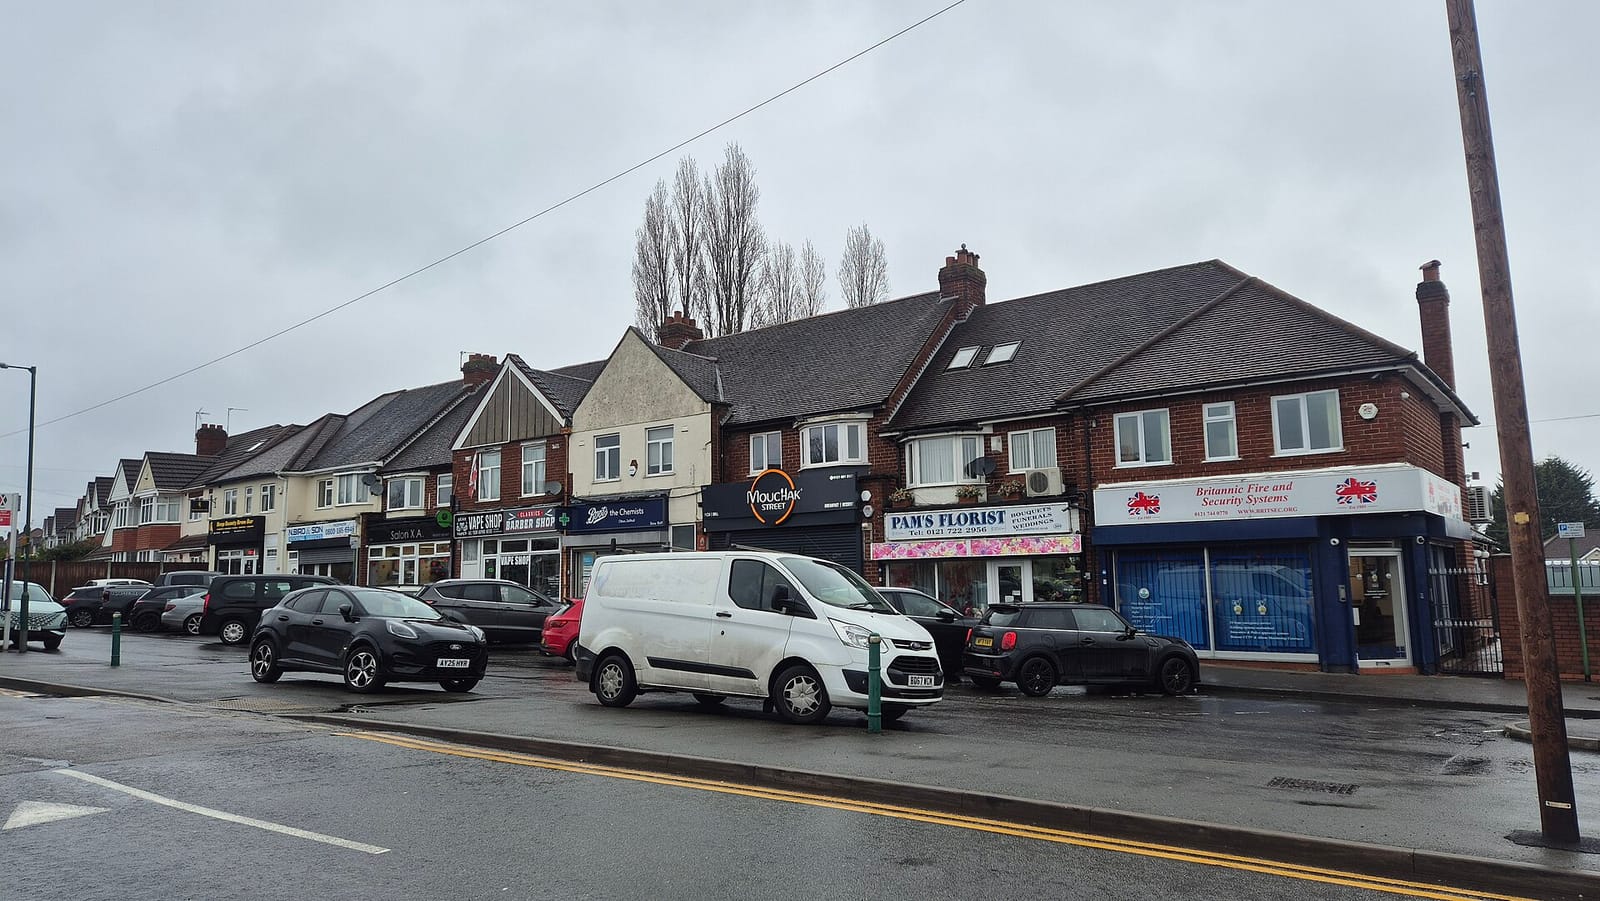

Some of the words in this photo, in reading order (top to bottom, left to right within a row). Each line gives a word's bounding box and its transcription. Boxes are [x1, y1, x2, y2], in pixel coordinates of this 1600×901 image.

[1196, 485, 1244, 497] Britannic
[1247, 483, 1270, 493] Fire
[1272, 481, 1294, 492] and
[1201, 496, 1244, 507] Security
[1245, 494, 1289, 506] Systems
[609, 508, 619, 517] the
[619, 507, 645, 516] Chemists
[761, 502, 787, 511] STREET
[1010, 507, 1052, 518] BOUQUETS
[468, 515, 485, 531] VAPE
[486, 513, 503, 530] SHOP
[506, 518, 534, 531] BARBER
[535, 516, 556, 529] SHOP
[891, 514, 935, 530] PAM'S
[938, 510, 1006, 528] FLORIST
[1011, 513, 1053, 524] FUNERALS
[311, 526, 324, 534] SON
[1012, 519, 1054, 530] WEDDINGS
[391, 531, 410, 541] Salon
[500, 556, 514, 566] VAPE
[514, 555, 529, 566] SHOP
